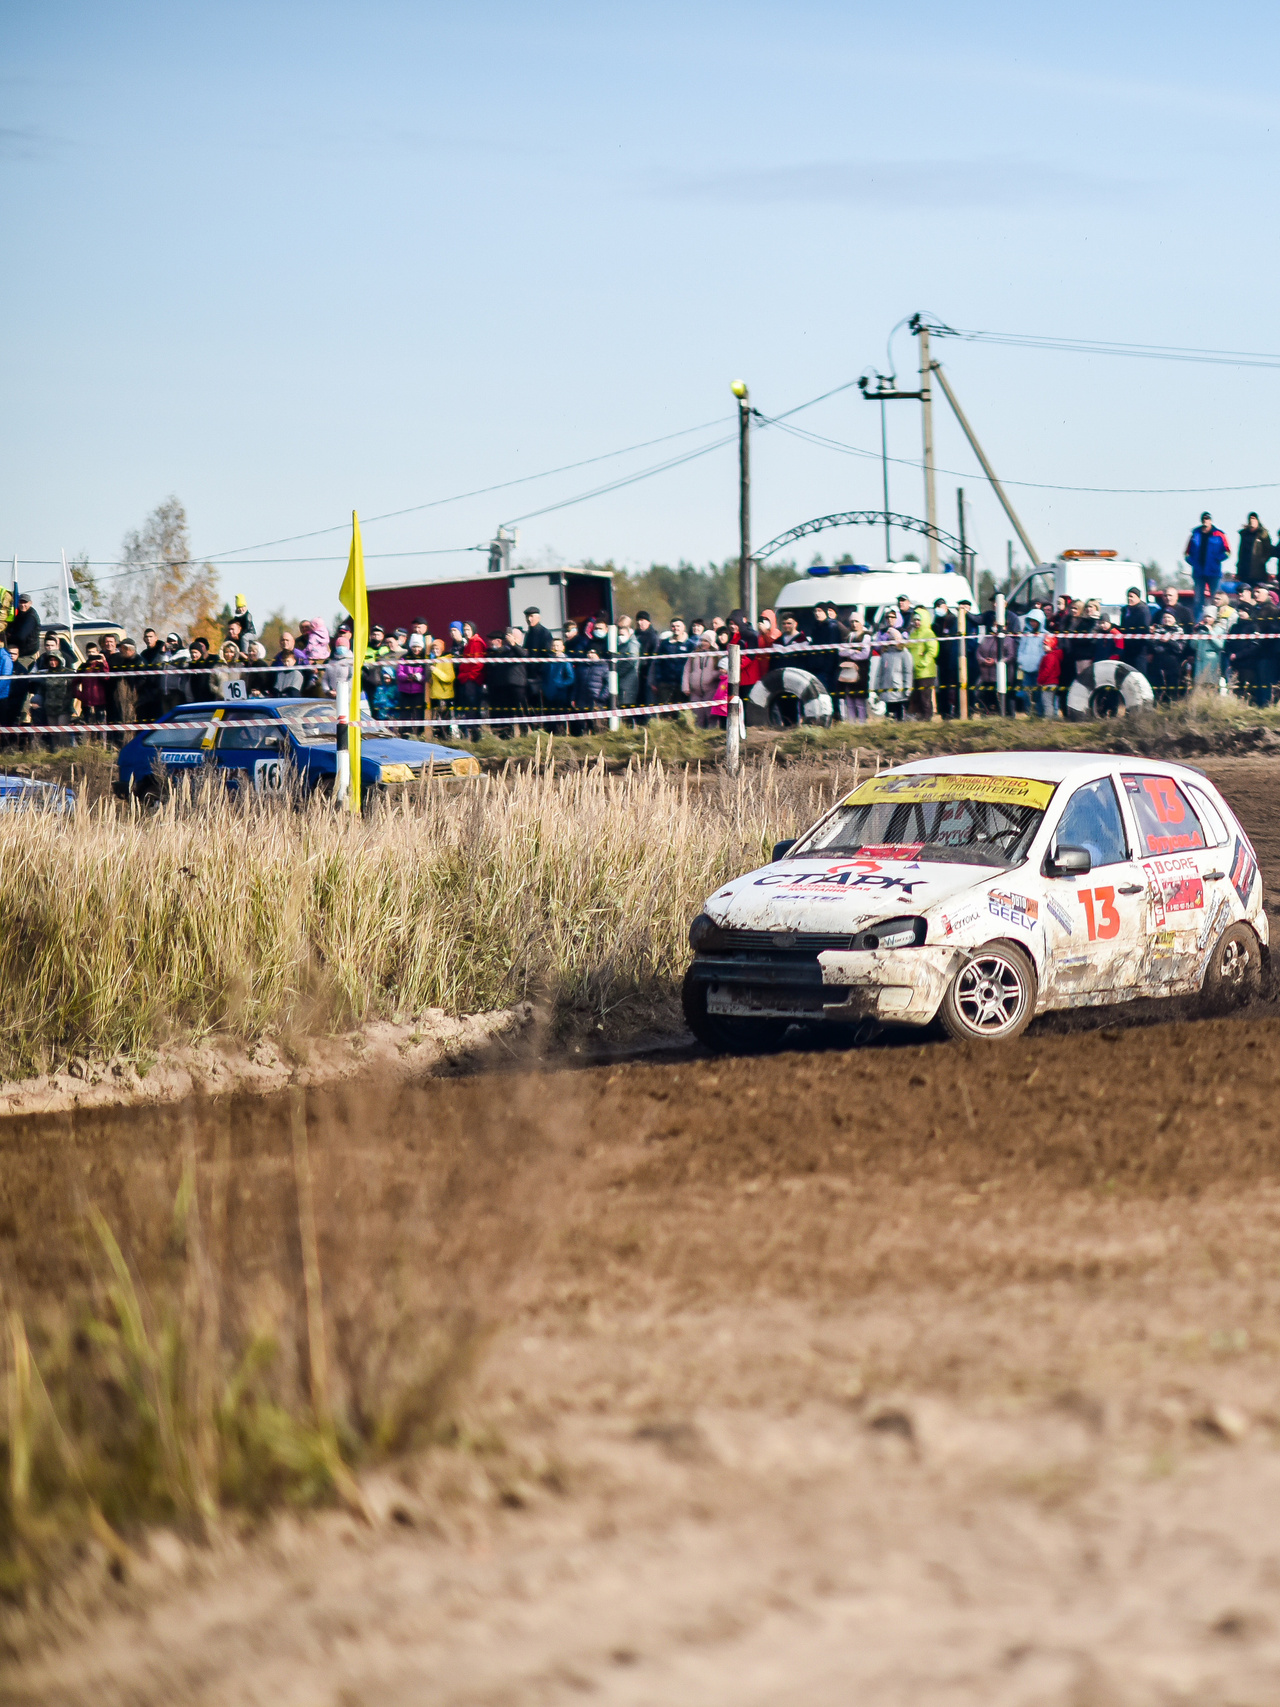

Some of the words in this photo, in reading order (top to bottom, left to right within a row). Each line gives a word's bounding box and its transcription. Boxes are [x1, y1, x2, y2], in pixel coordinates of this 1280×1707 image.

[227, 682, 242, 698] 16
[258, 763, 281, 791] 16
[945, 776, 1029, 788] ПРОИЗВОДСТВО
[948, 783, 1030, 797] ГЛУШИТЕЛЕЙ
[1142, 778, 1186, 824] 13
[753, 871, 930, 895] СТАРК
[988, 902, 1037, 931] GEELY
[1077, 885, 1121, 942] 13
